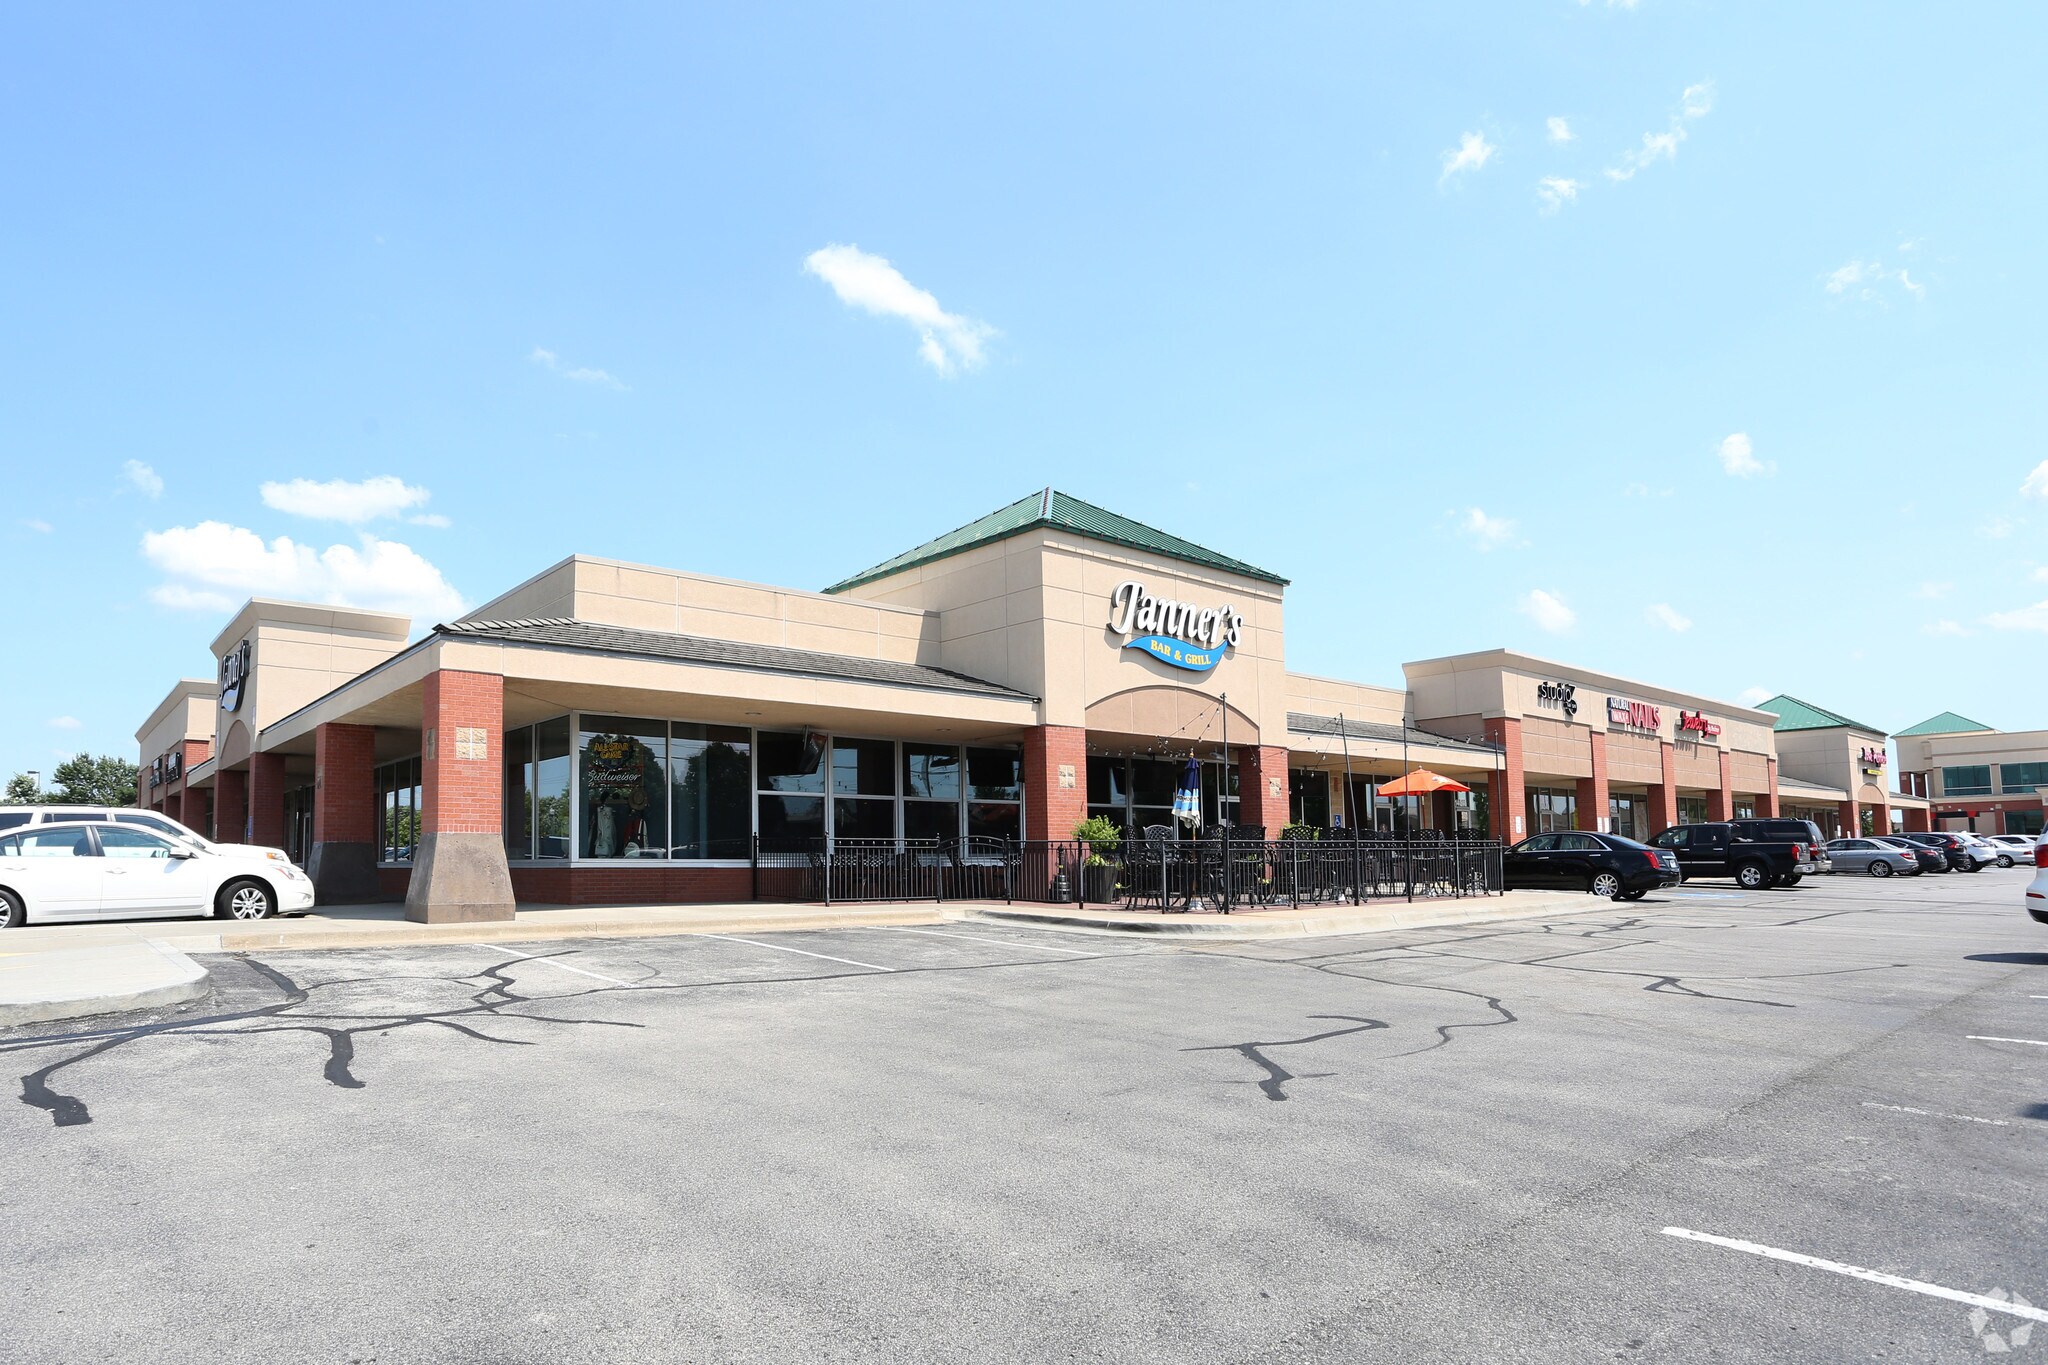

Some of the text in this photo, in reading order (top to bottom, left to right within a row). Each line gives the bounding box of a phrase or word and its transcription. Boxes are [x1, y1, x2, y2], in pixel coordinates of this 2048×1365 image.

[1107, 581, 1243, 647] Tanner's
[1151, 640, 1211, 665] BAR & GRILL
[1629, 701, 1660, 730] NAILS
[588, 769, 641, 783] Budweiser
